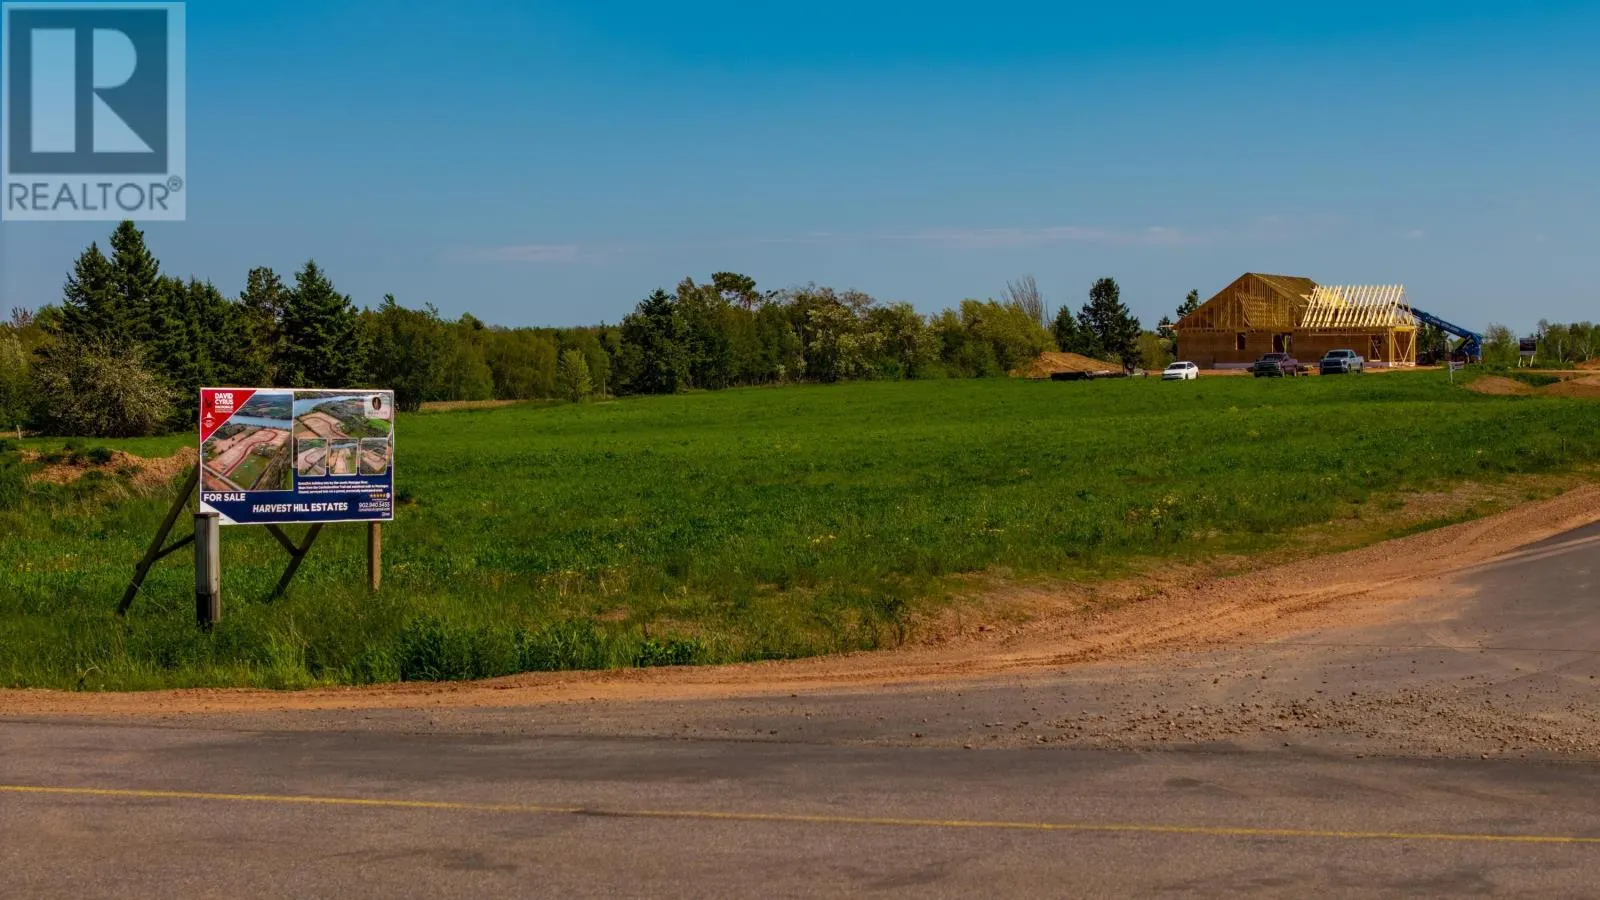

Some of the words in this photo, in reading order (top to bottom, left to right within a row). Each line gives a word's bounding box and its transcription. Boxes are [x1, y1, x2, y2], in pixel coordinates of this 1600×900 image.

[224, 492, 246, 502] SALE
[252, 504, 292, 512] HARVEST
[293, 503, 309, 512] HILL
[311, 502, 348, 511] ESTATES
